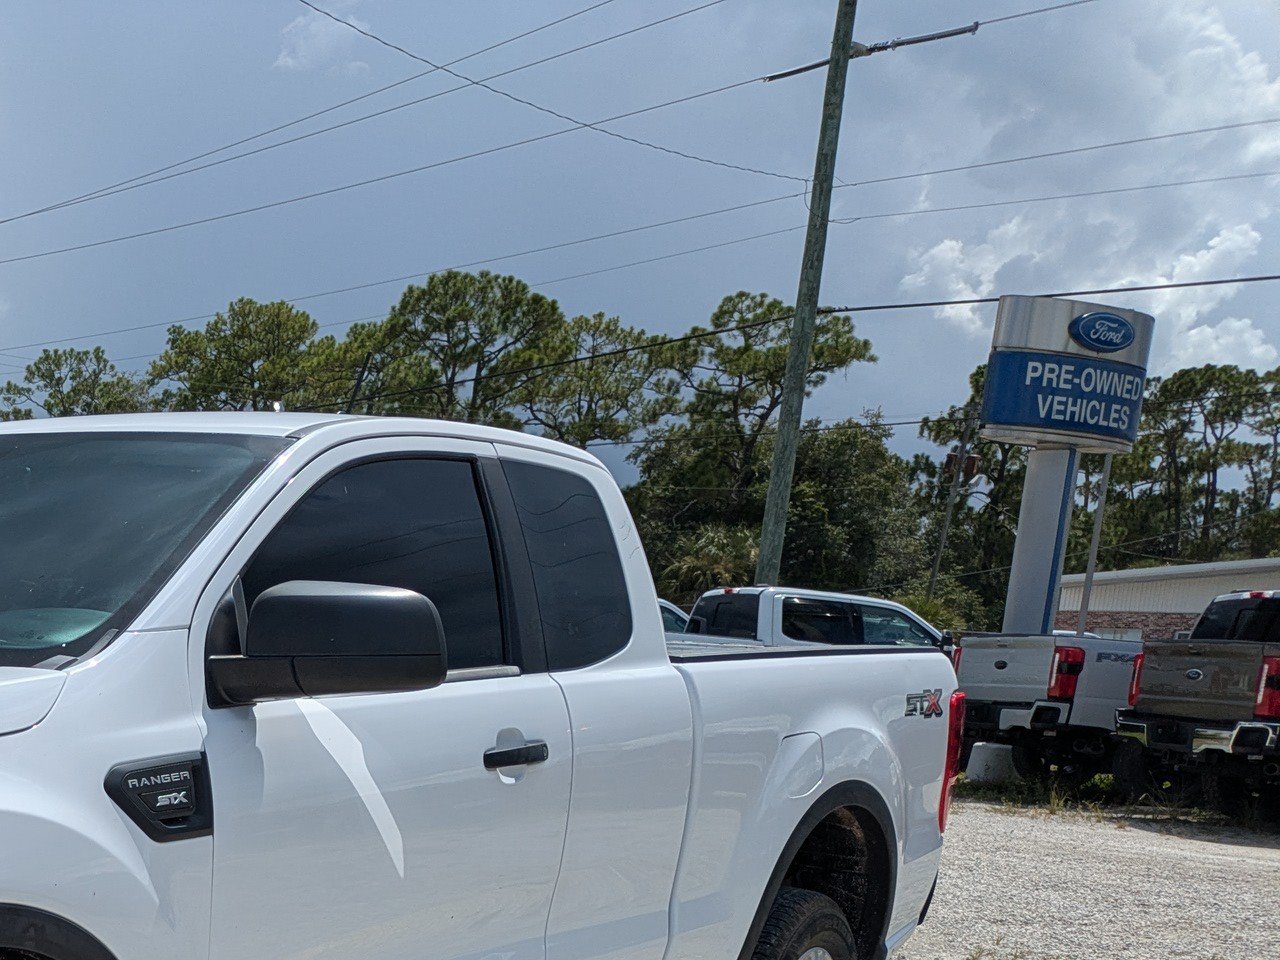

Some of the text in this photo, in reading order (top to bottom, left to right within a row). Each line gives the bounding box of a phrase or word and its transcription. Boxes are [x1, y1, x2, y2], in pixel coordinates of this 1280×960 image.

[1090, 320, 1124, 343] Ford
[1025, 361, 1141, 400] PRE-OWNED
[1037, 393, 1130, 430] VEHICLES
[905, 689, 942, 719] STX
[128, 771, 190, 788] RANGER
[156, 791, 188, 806] STX
